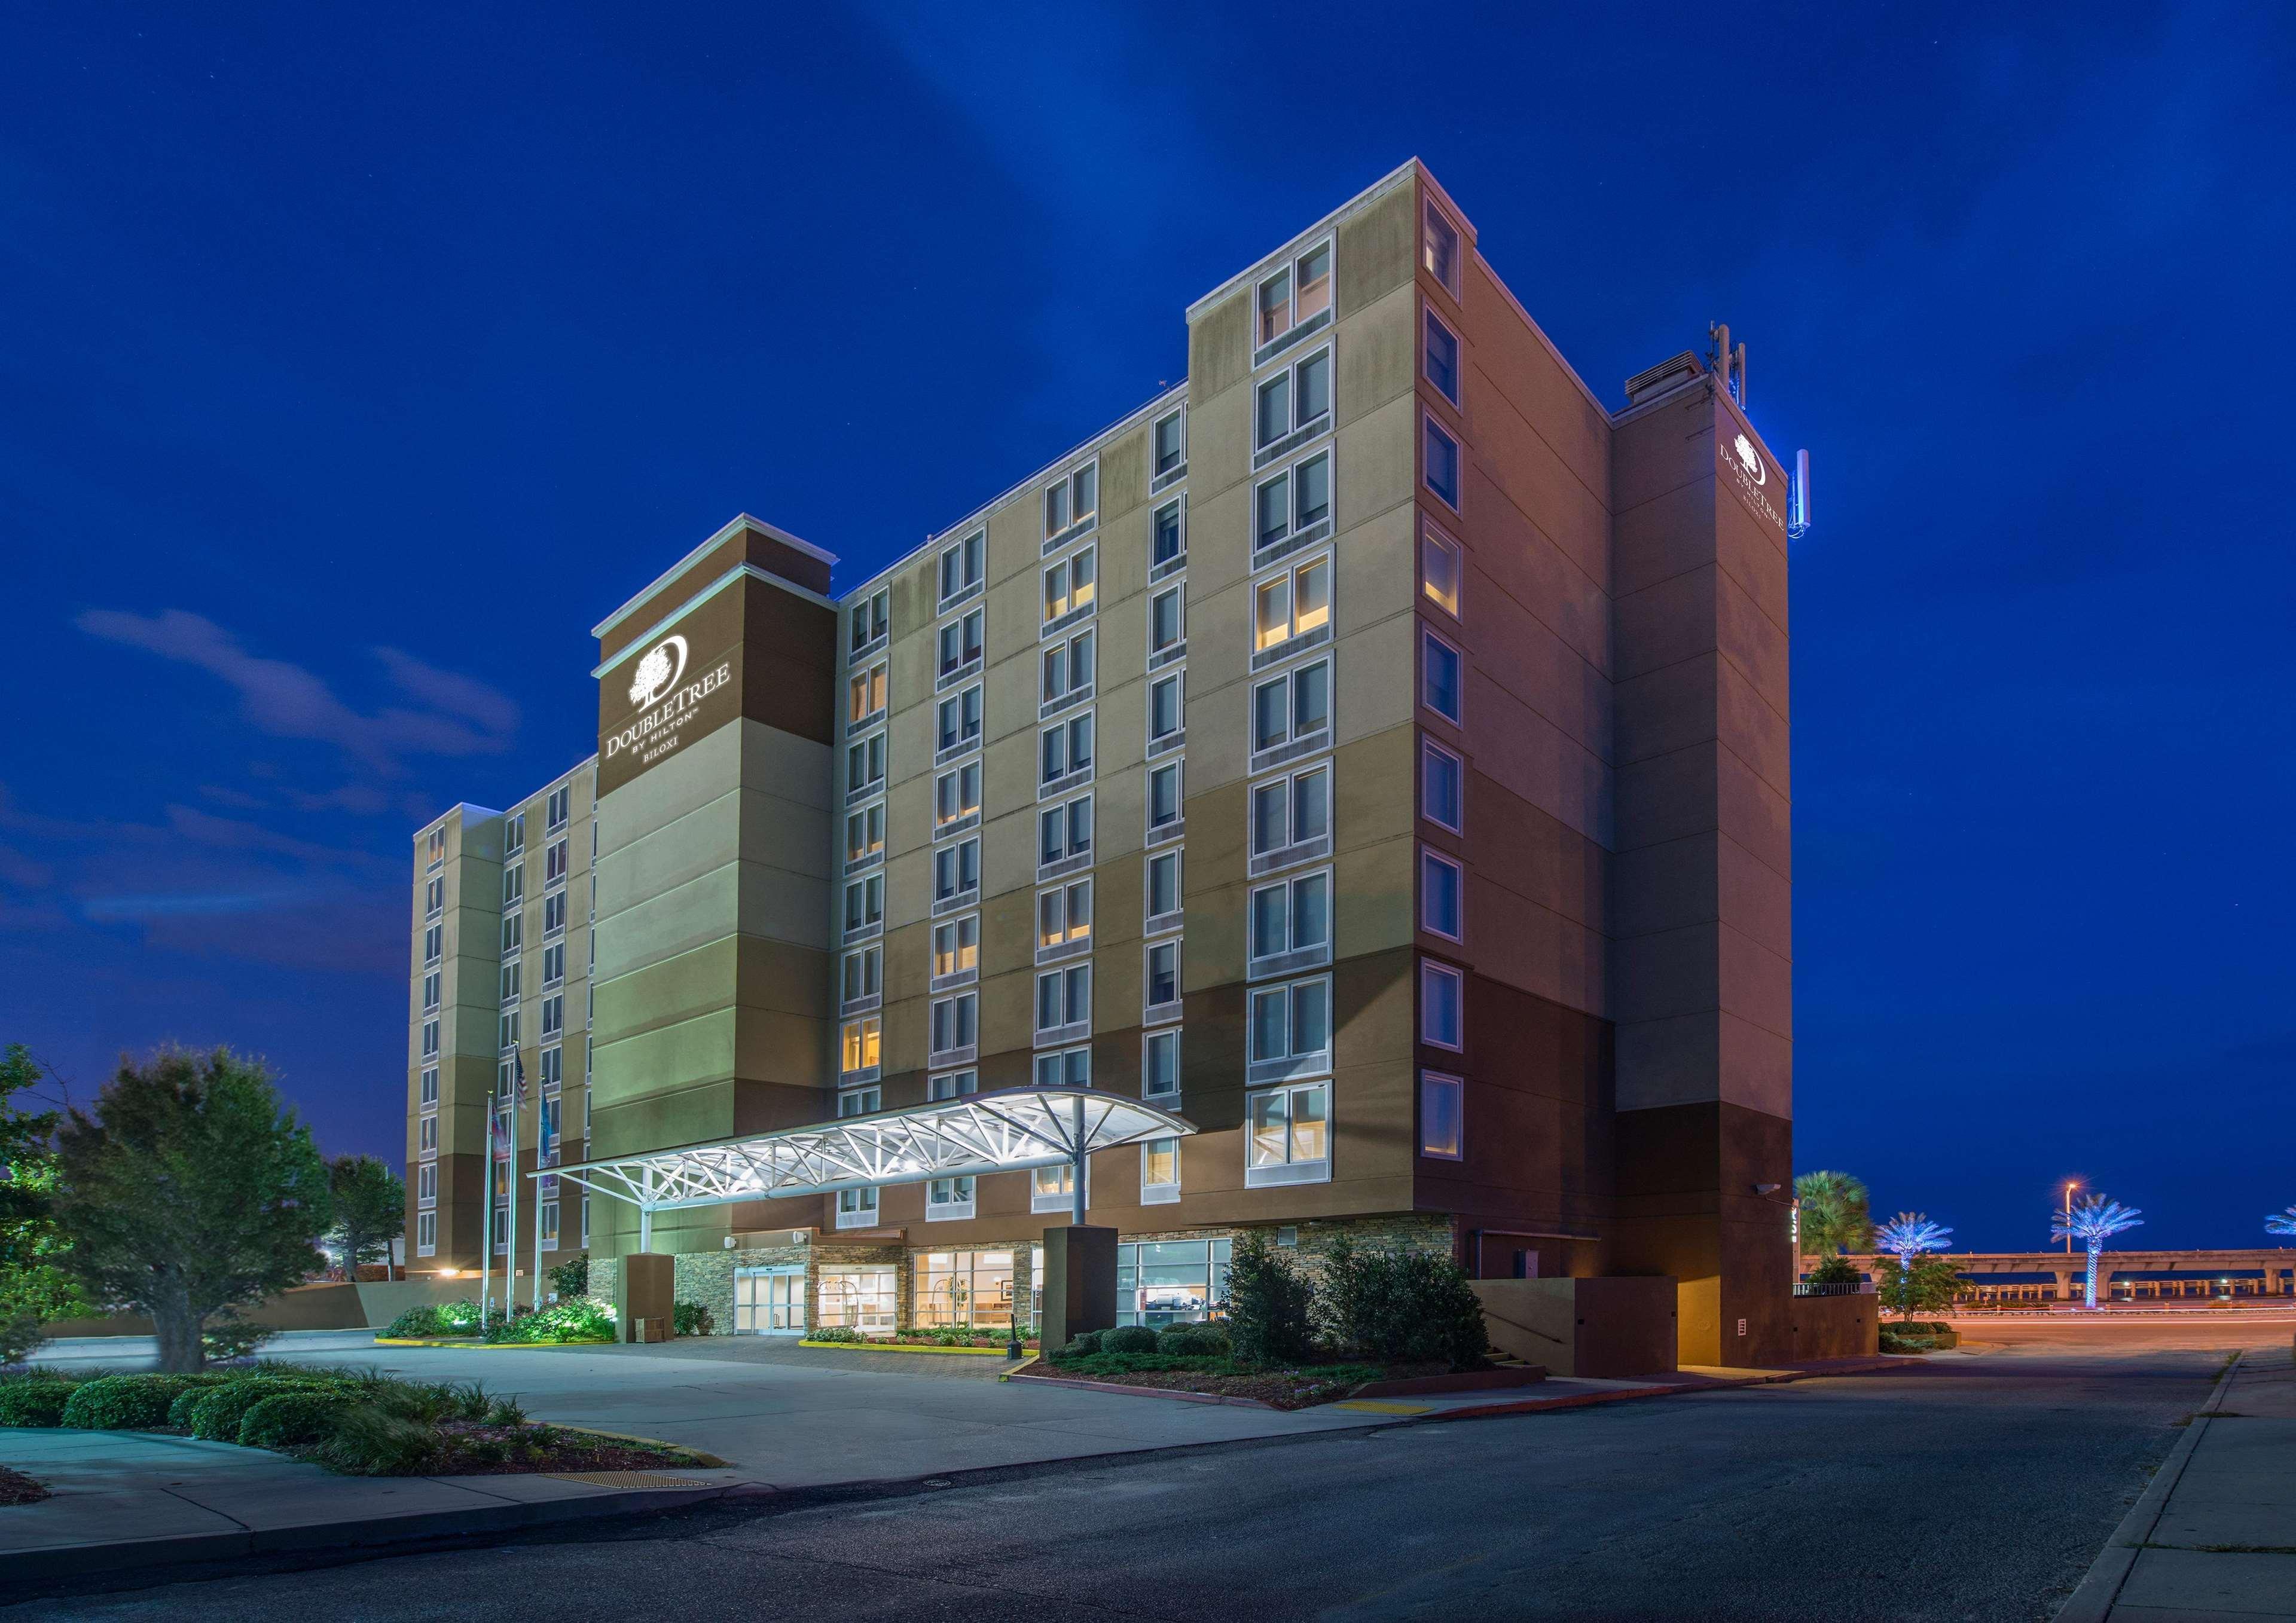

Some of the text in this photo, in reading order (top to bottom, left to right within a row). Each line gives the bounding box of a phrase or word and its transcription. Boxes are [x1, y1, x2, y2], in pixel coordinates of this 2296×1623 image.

[1720, 444, 1784, 531] DOUBLETREE
[606, 664, 731, 758] DOUBLETREE
[632, 741, 645, 754] BY
[643, 736, 679, 762] BILOXI
